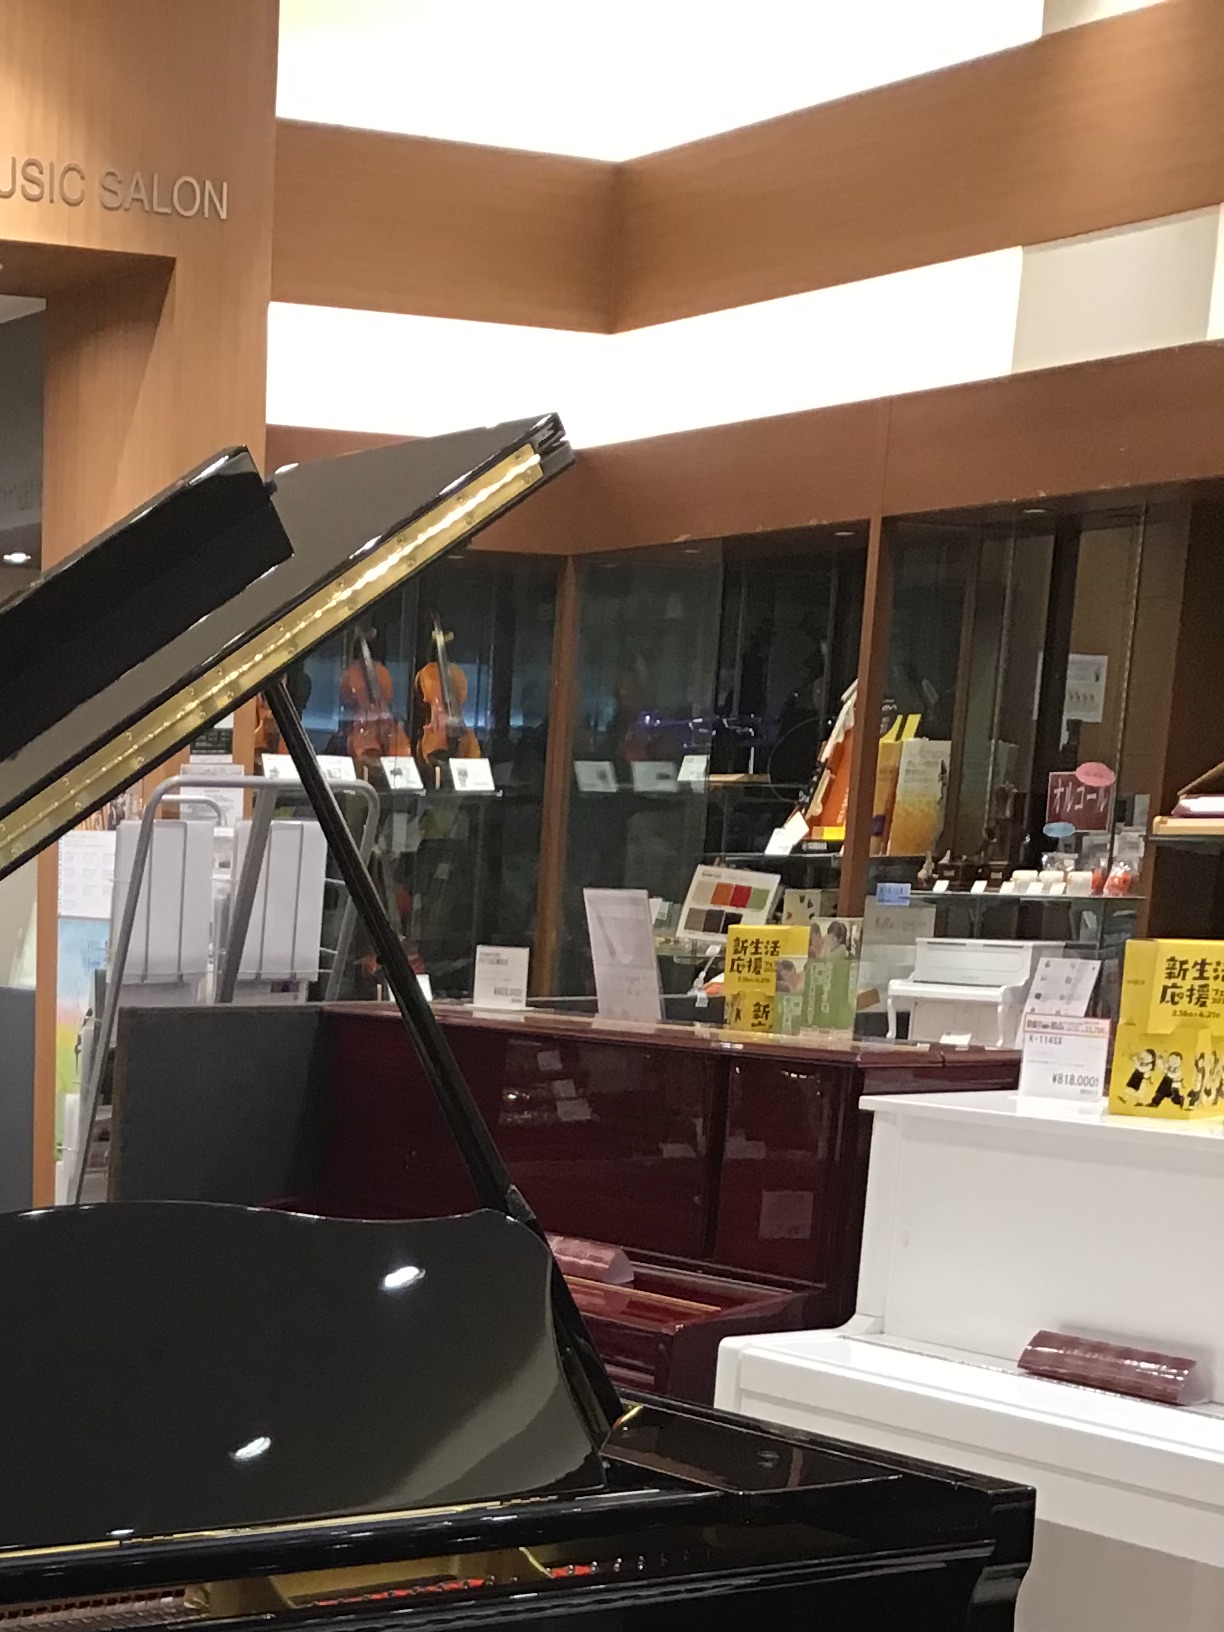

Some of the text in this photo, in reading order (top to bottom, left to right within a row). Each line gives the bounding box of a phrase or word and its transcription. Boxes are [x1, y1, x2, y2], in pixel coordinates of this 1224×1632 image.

[100, 170, 229, 220] SALON
[733, 936, 781, 956] 新生活
[730, 956, 763, 975] 応援
[1159, 982, 1211, 1008] 応援
[752, 1001, 771, 1020] 新
